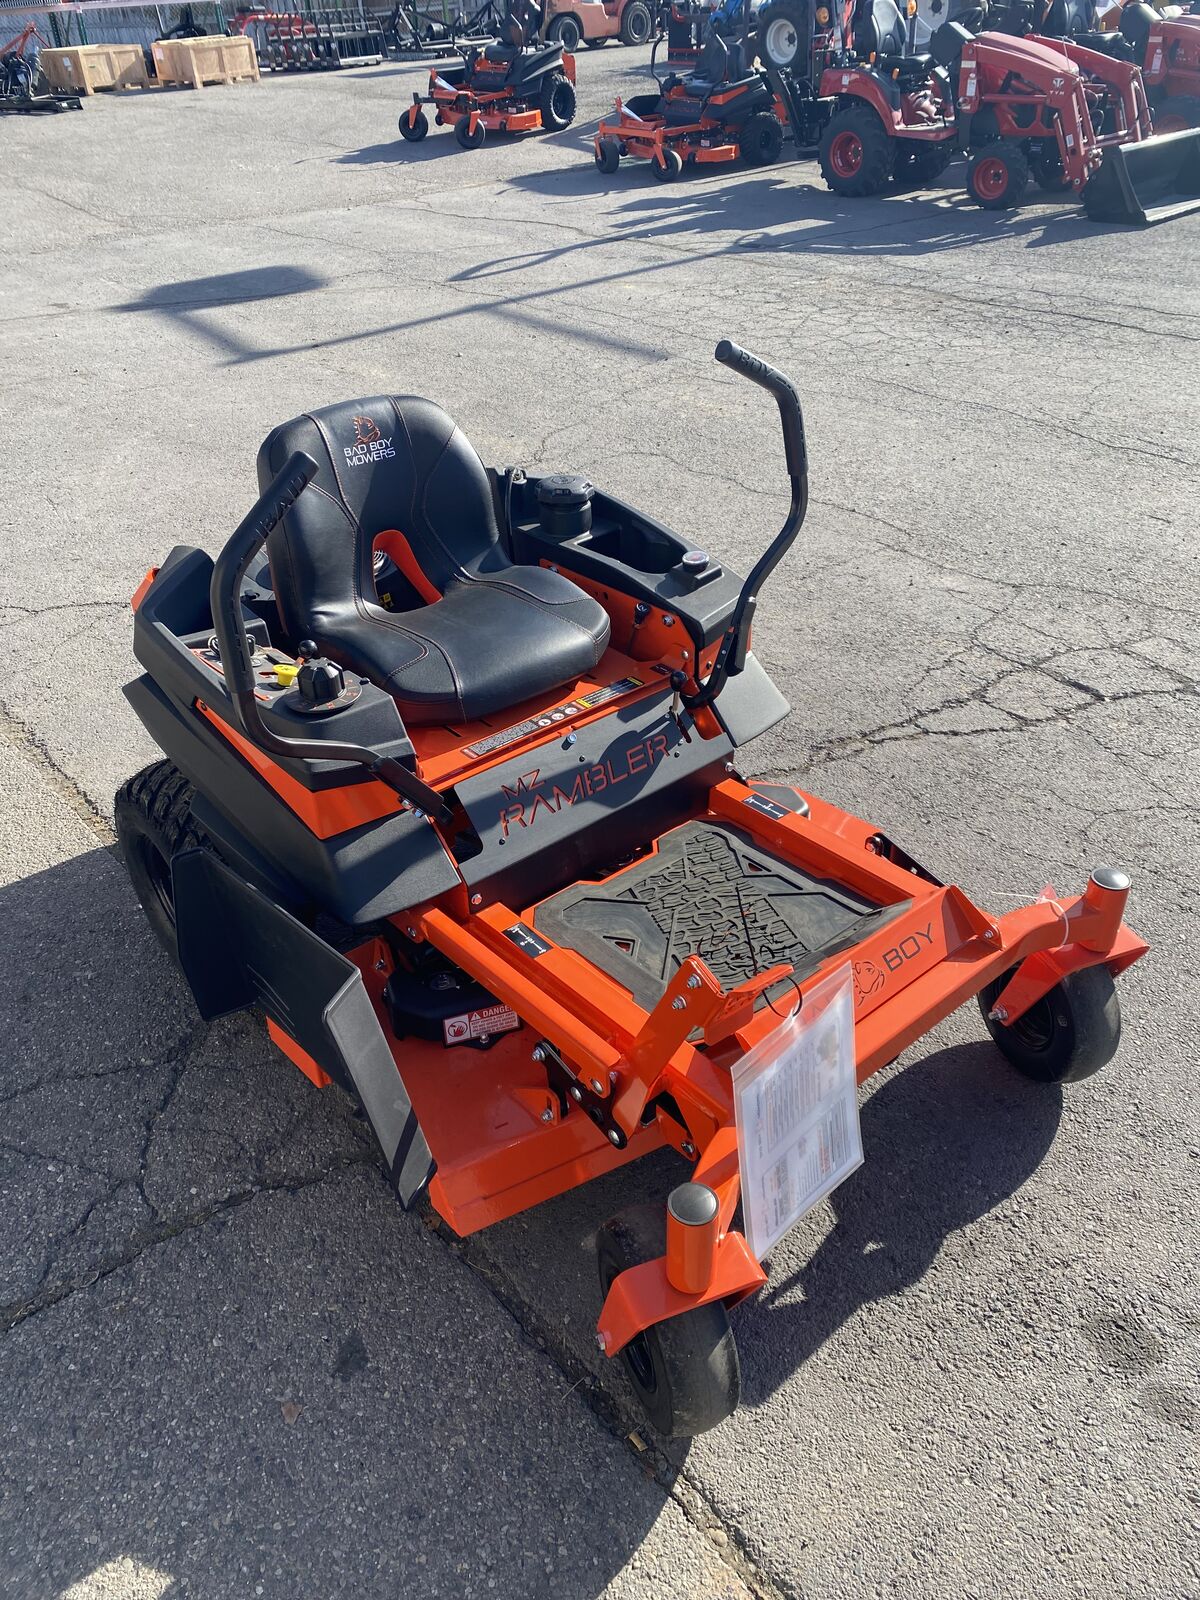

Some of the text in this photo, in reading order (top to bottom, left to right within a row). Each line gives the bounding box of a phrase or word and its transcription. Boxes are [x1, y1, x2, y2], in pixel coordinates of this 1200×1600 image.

[343, 437, 392, 457] BAD BOY
[346, 447, 396, 467] MOWERS
[499, 734, 670, 837] RAMBLER
[501, 768, 546, 800] MZ
[882, 922, 933, 972] BOY
[482, 1005, 512, 1018] DANGE
